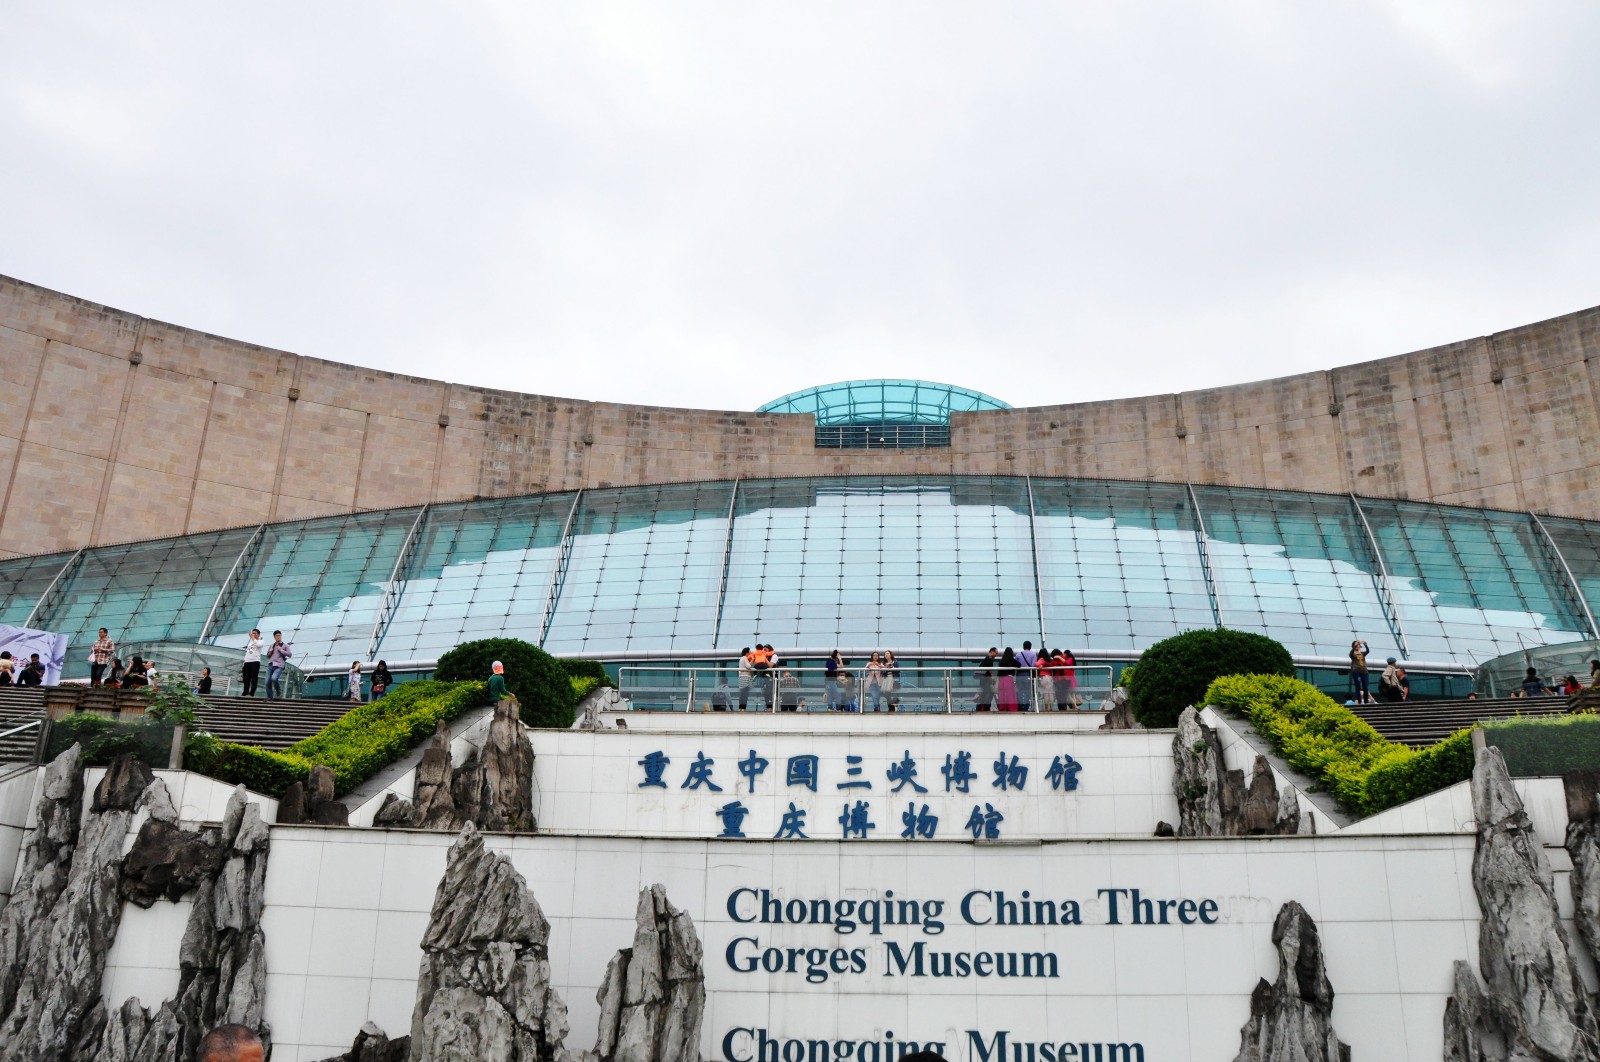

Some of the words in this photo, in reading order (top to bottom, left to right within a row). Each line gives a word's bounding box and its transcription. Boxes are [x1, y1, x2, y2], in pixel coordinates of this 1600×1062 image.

[638, 750, 1082, 793] 重庆中国三峡博物馆
[715, 801, 1003, 839] 重庆博物馆
[727, 888, 945, 936] Chongqing
[961, 890, 1082, 925] China
[1097, 888, 1218, 924] Three
[726, 937, 867, 984] Gorges
[883, 941, 1059, 977] Museum
[964, 1030, 1144, 1062] Museum
